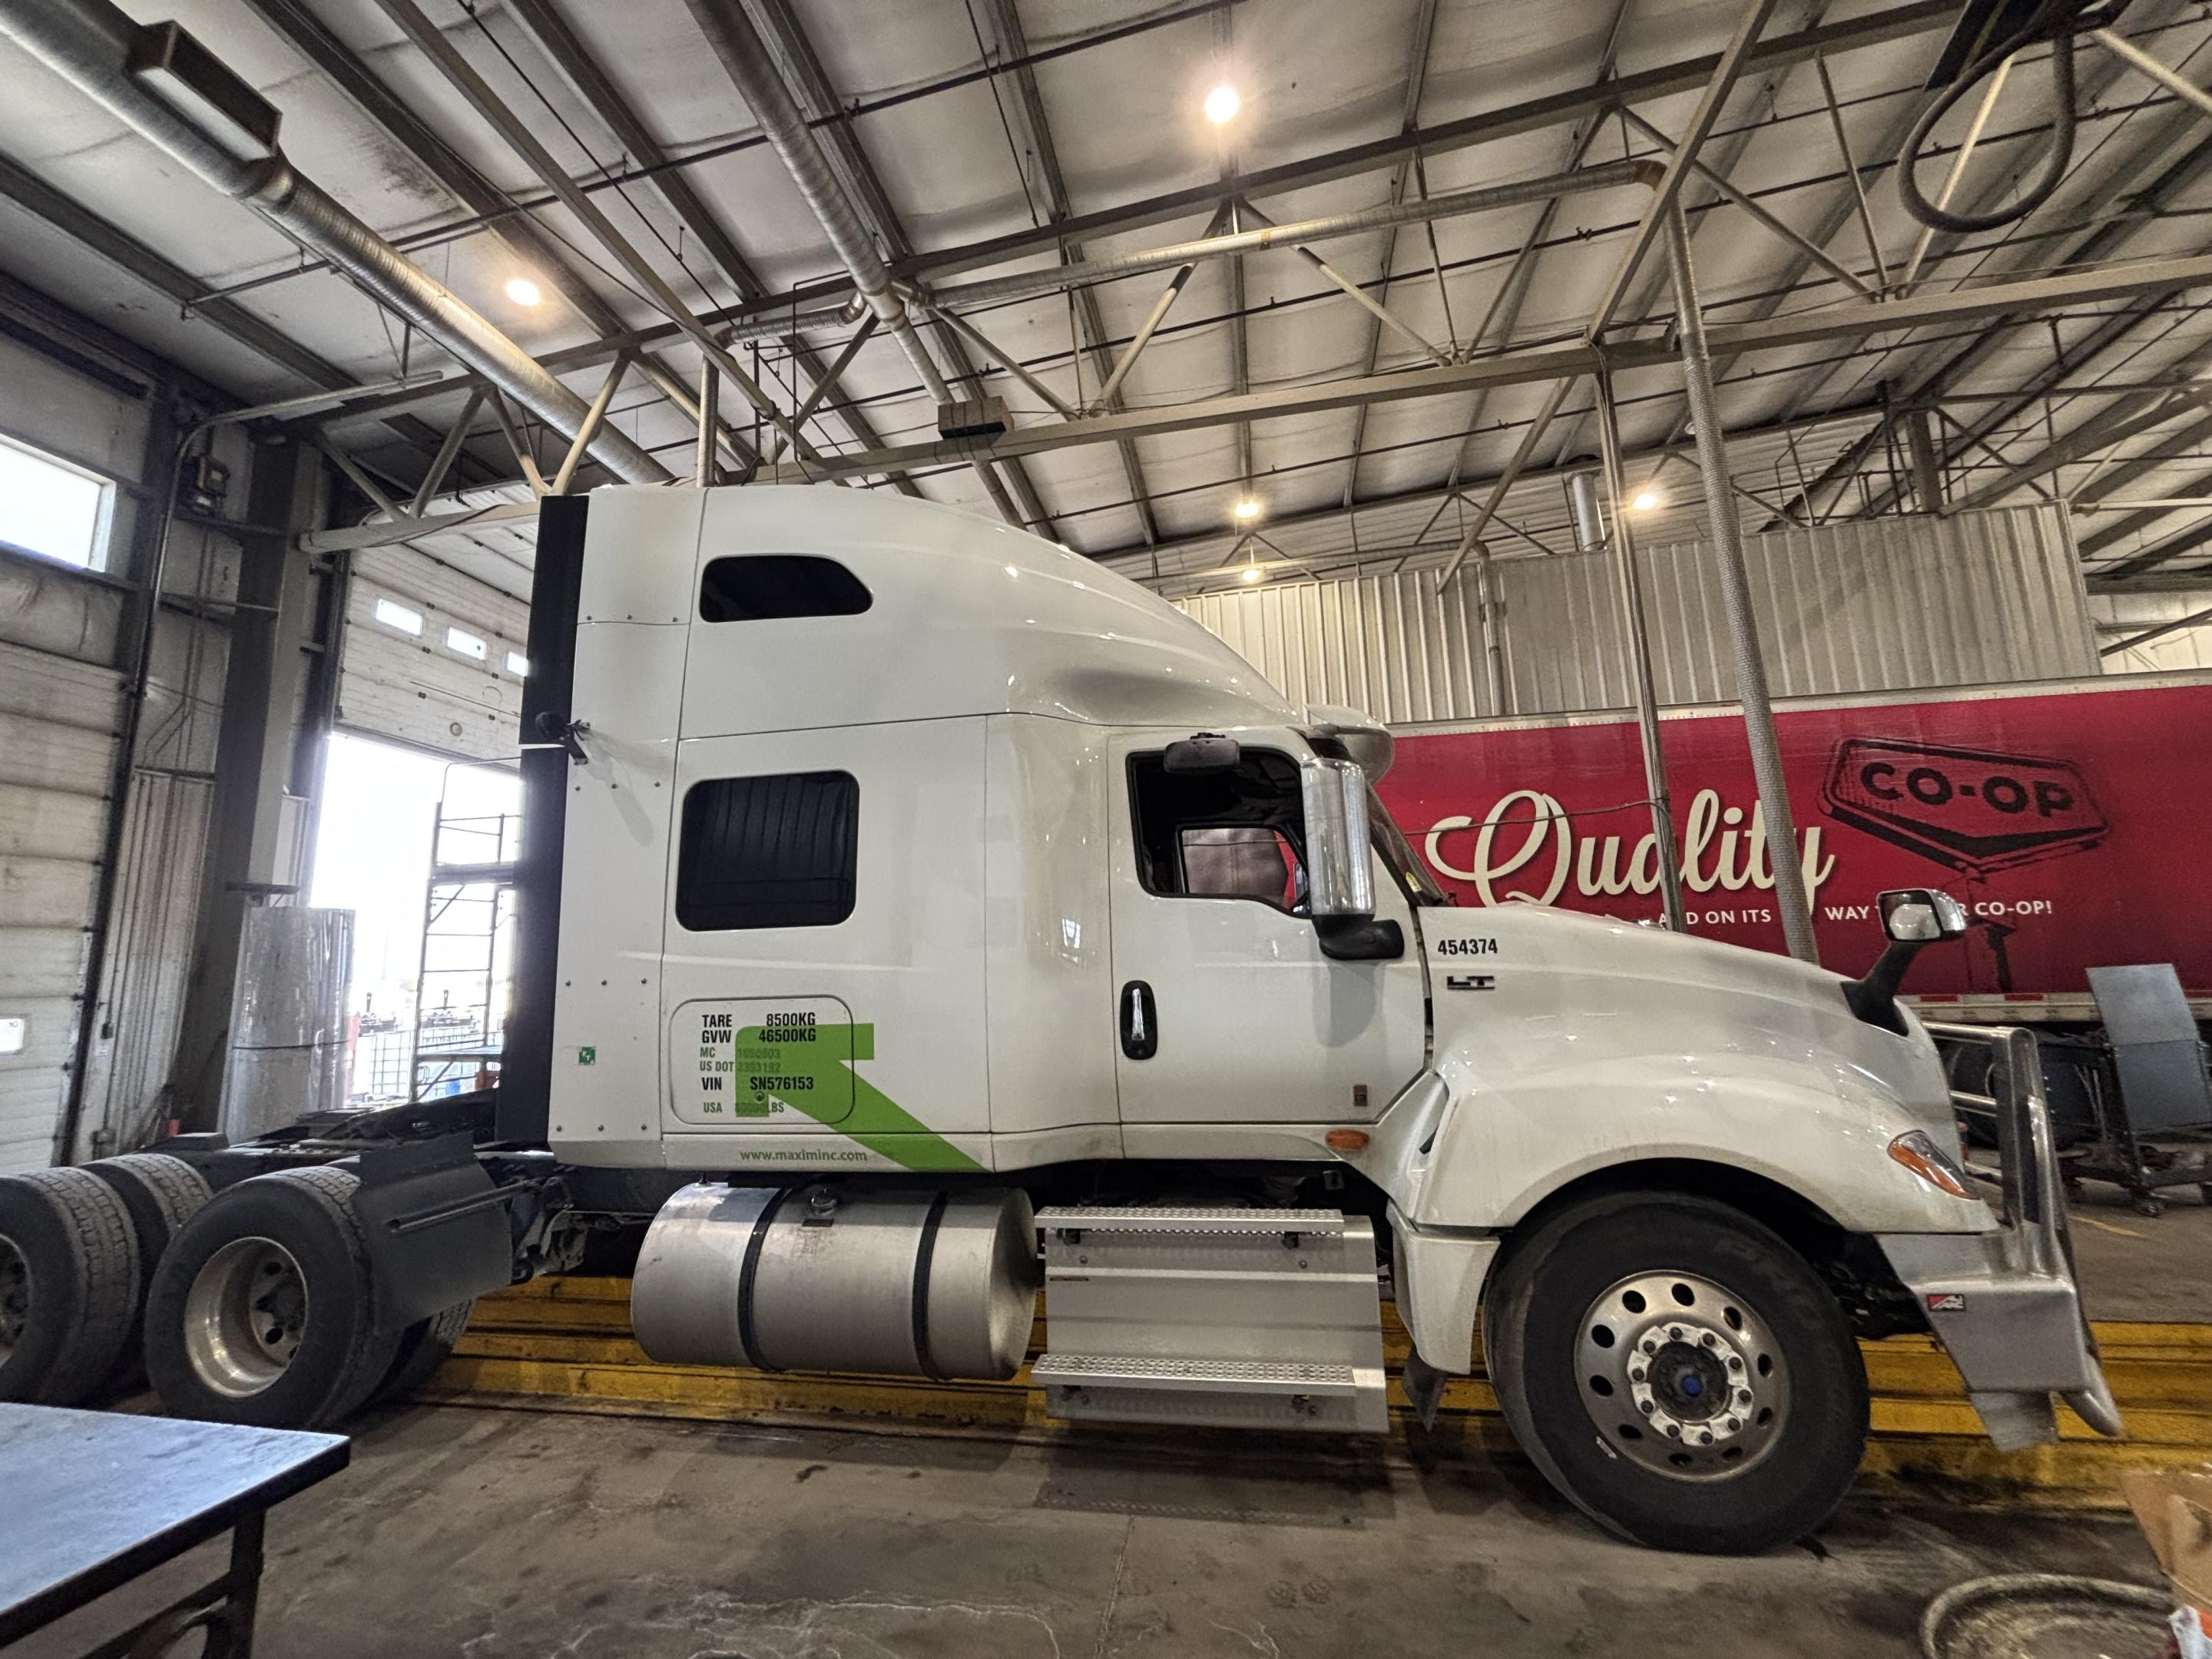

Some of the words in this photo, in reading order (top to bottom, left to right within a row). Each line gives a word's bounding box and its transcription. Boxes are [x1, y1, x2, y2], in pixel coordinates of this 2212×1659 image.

[1859, 762, 2073, 818] CO-OP
[1425, 789, 1836, 916] Quality
[1705, 910, 1735, 924] ON
[1743, 909, 1772, 923] ITS
[1824, 906, 1869, 920] WAY
[1975, 900, 2052, 916] CO-OP!
[1438, 939, 1498, 955] 454374
[702, 1015, 732, 1028] TARE
[766, 1012, 816, 1026] 8500KG
[702, 1030, 731, 1044] GVW
[759, 1028, 816, 1042] 46500KG
[700, 1047, 715, 1058] MC
[700, 1061, 712, 1071] US
[716, 1061, 734, 1072] DOT
[702, 1077, 722, 1090] VIN
[750, 1077, 814, 1090] SN576153
[704, 1102, 723, 1113] USA
[740, 1149, 868, 1162] www.maximinc.com
